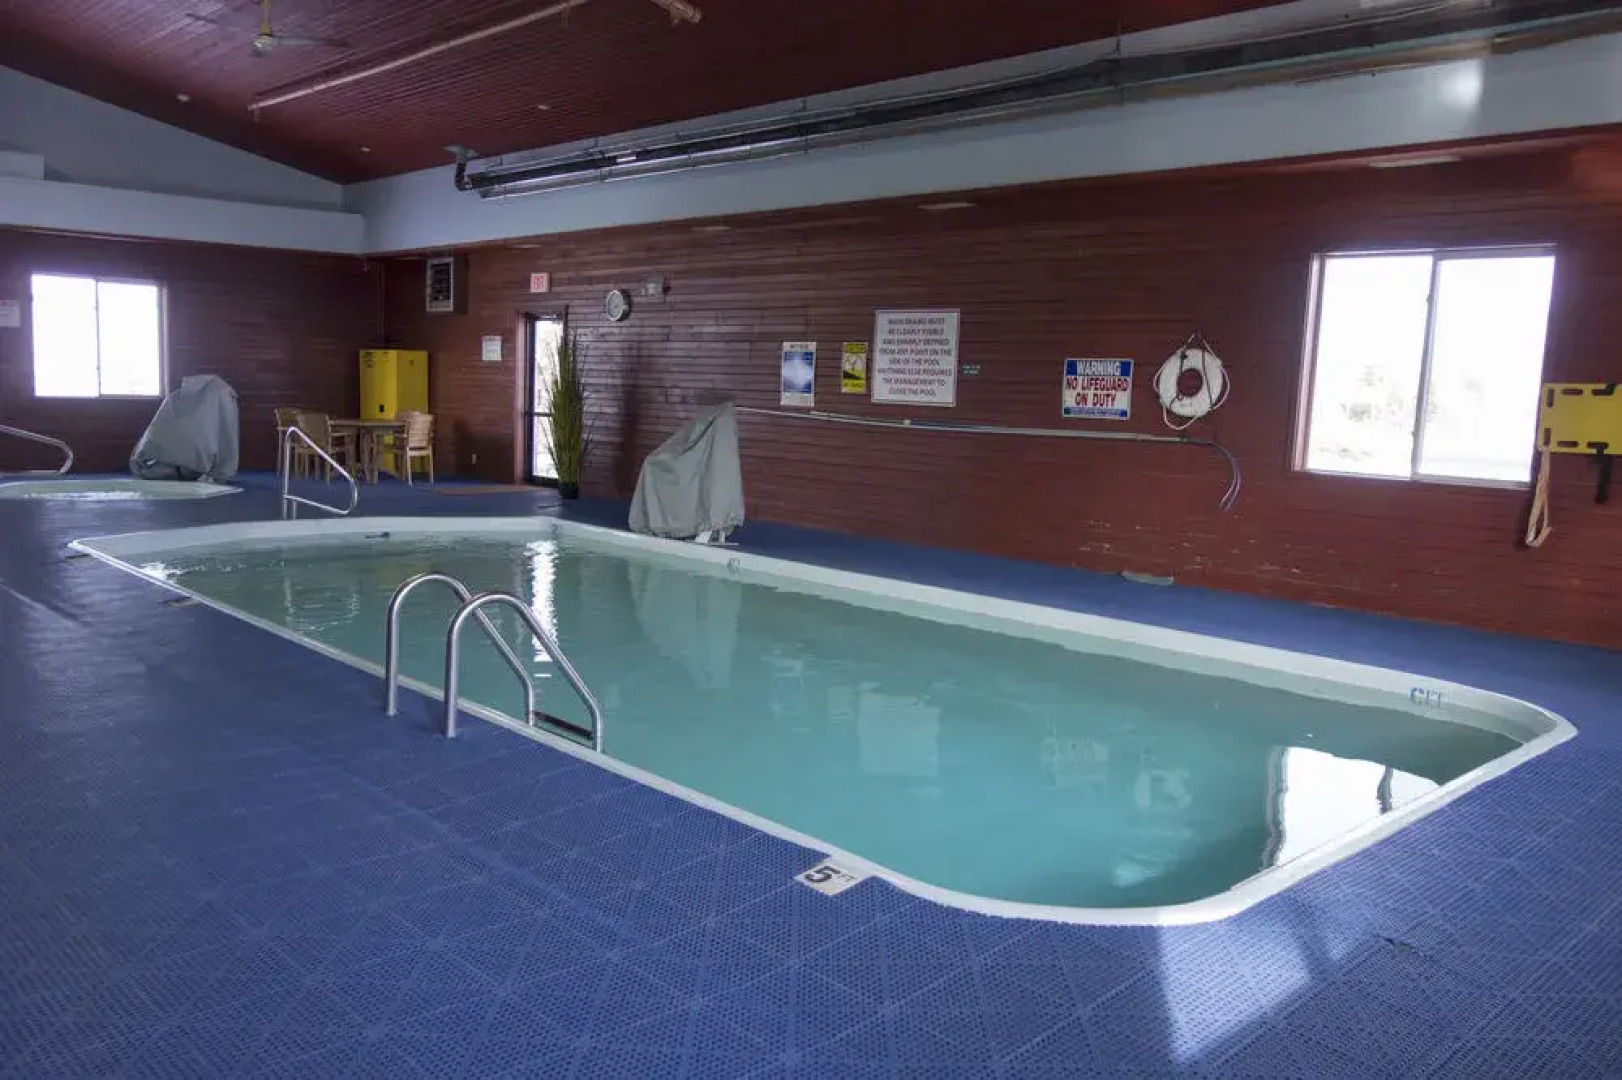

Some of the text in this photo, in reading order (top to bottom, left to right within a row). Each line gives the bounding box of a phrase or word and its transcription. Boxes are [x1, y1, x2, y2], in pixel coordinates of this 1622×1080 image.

[879, 348, 952, 356] FROM ANY POINT ON THE
[901, 358, 910, 366] OF
[911, 358, 922, 366] THE
[1077, 360, 1121, 376] WARNING
[1066, 377, 1130, 392] NO LIFEGUARD
[907, 388, 918, 397] THE
[1075, 392, 1116, 408] ON DUTY
[804, 865, 841, 883] 5
